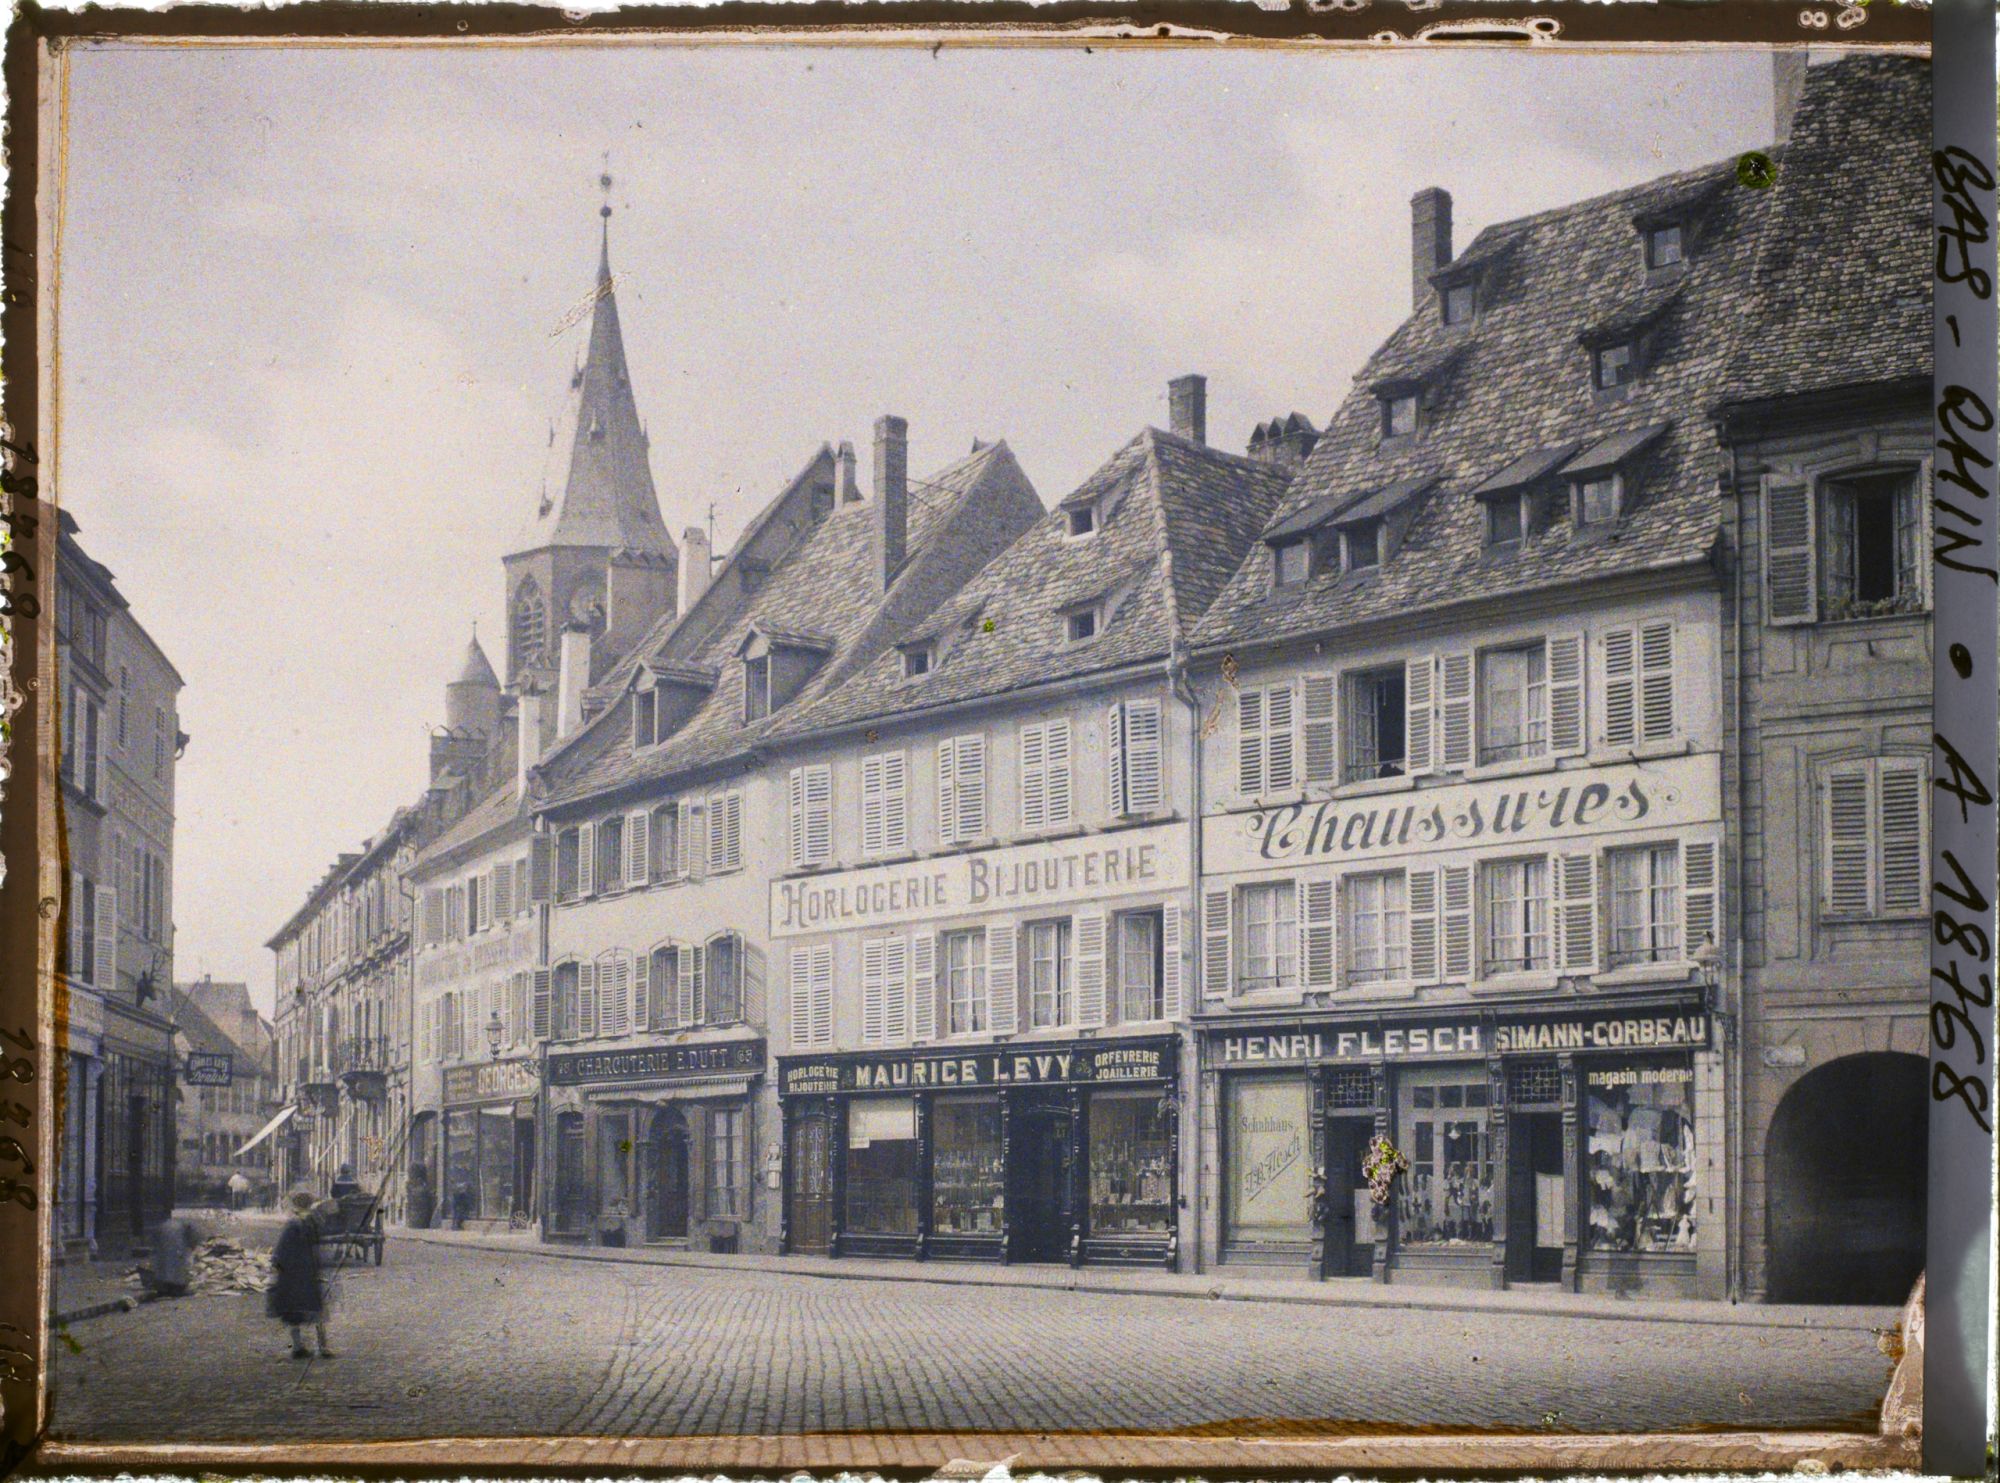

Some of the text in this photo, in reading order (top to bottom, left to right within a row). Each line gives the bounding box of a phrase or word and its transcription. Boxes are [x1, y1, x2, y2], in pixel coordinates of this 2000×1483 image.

[1934, 146, 1996, 299] BAS
[1934, 385, 1997, 584] RHIN
[1245, 779, 1650, 859] Chaussures
[780, 844, 1156, 928] HORLOGERIE BIJOUTERIE
[1931, 850, 1993, 1134] 18768
[1224, 1026, 1480, 1060] HENRI FLESCH
[1496, 1016, 1706, 1051] SIMANN-CORBEAU
[577, 1054, 669, 1076] CHARCUTERIE
[855, 1054, 1072, 1087] MAURICE LEVY
[1094, 1051, 1160, 1068] ORFEVRERIE
[1096, 1066, 1159, 1080] JOAILLERIE
[1588, 1067, 1693, 1087] magasin moderne
[1242, 1116, 1294, 1133] Schuhhaus
